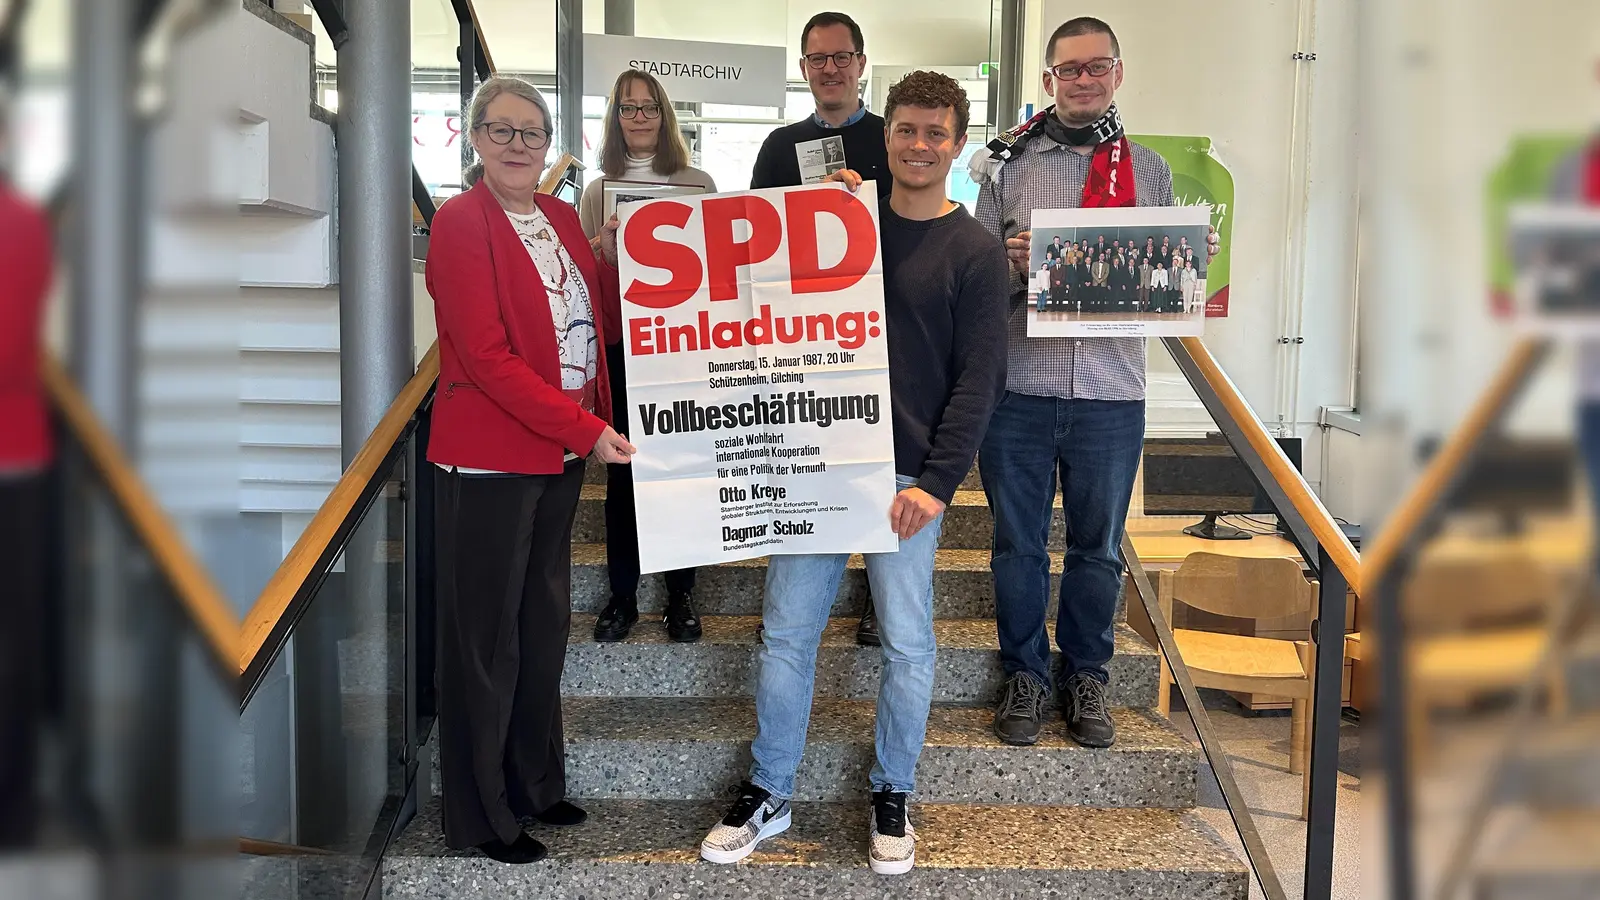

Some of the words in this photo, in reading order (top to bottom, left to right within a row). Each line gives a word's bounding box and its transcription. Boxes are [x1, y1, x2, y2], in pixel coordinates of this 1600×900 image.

[629, 60, 742, 80] STADTARCHIV
[623, 188, 877, 309] SPD
[629, 305, 880, 356] Einladung:
[708, 358, 757, 373] Donnerstag,
[758, 357, 771, 369] 15.
[773, 355, 801, 367] Januar
[802, 353, 826, 366] 1987,
[827, 353, 838, 364] 20
[840, 352, 855, 363] Uhr
[709, 374, 769, 389] Schützenheim,
[771, 371, 804, 385] Gilching
[638, 390, 880, 436] Vollbeschäftigung
[714, 435, 744, 449] soziale
[745, 432, 784, 447] Wohlfahrt
[715, 447, 770, 463] internationale
[771, 445, 820, 459] Kooperation
[717, 466, 730, 479] für
[731, 466, 749, 477] eine
[750, 463, 774, 476] Politik
[776, 463, 790, 475] der
[791, 462, 826, 474] Vernunft
[719, 486, 747, 503] Otto
[751, 483, 787, 501] Kreye
[783, 500, 819, 508] Erforschung
[721, 511, 744, 520] globaler
[745, 508, 774, 517] Strukturen,
[722, 524, 769, 543] Dagmar
[773, 520, 814, 536] Scholz
[723, 538, 784, 552] Bundestagskandidatin
